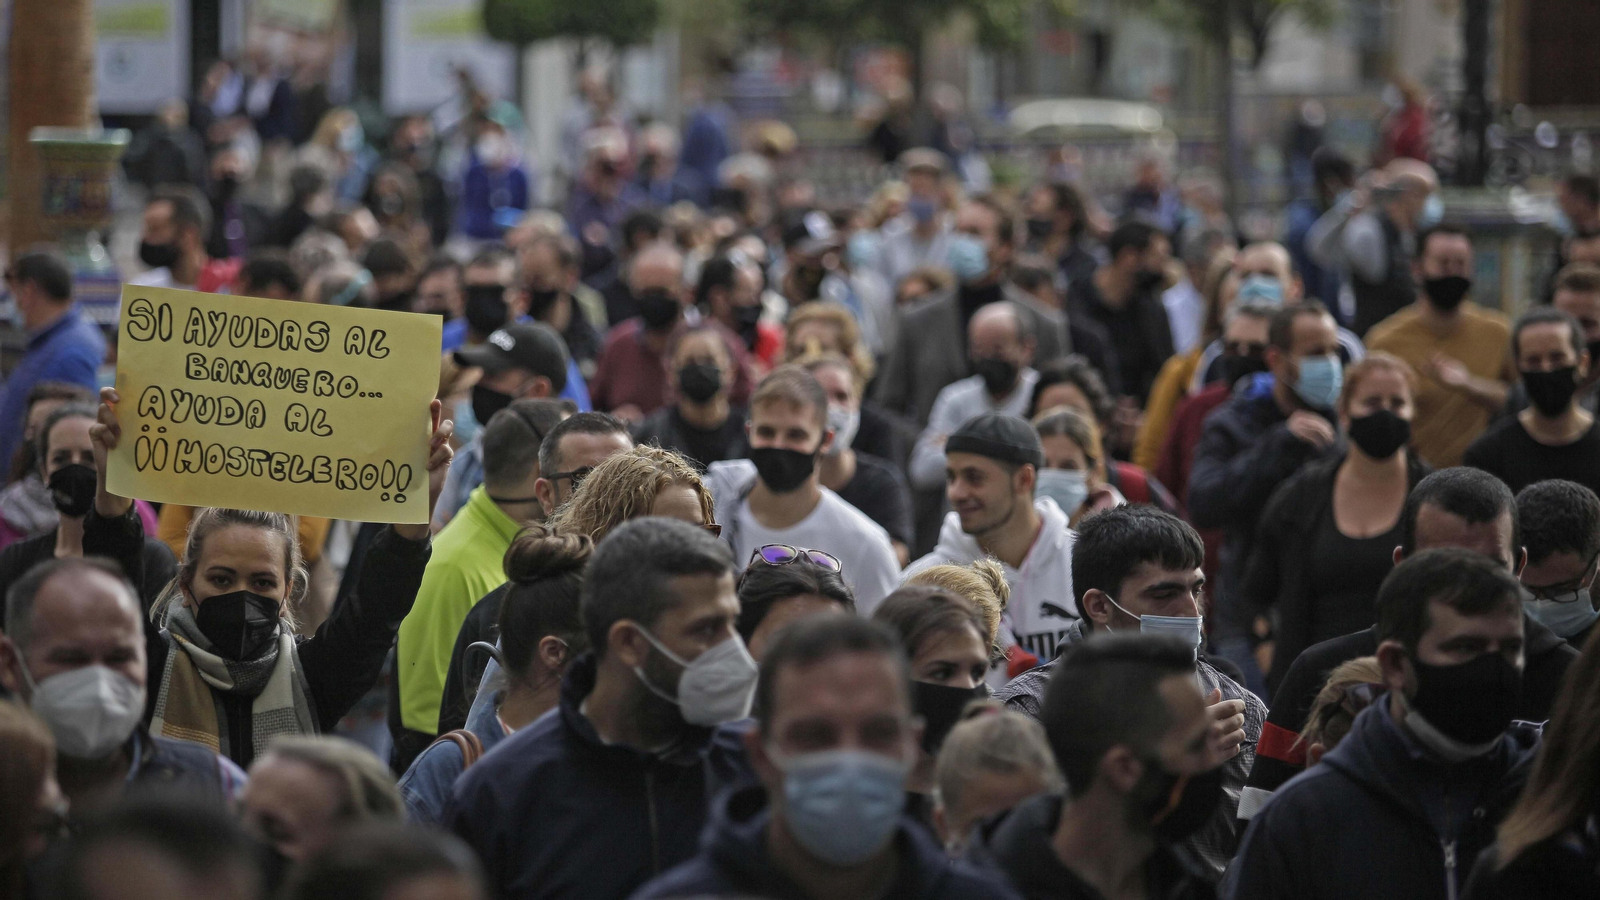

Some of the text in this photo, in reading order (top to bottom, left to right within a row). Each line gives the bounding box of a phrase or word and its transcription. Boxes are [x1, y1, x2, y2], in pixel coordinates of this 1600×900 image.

[126, 298, 391, 360] SI AYUDAS AL
[185, 352, 384, 399] BANQUERO...
[137, 384, 334, 437] AYUDA AL
